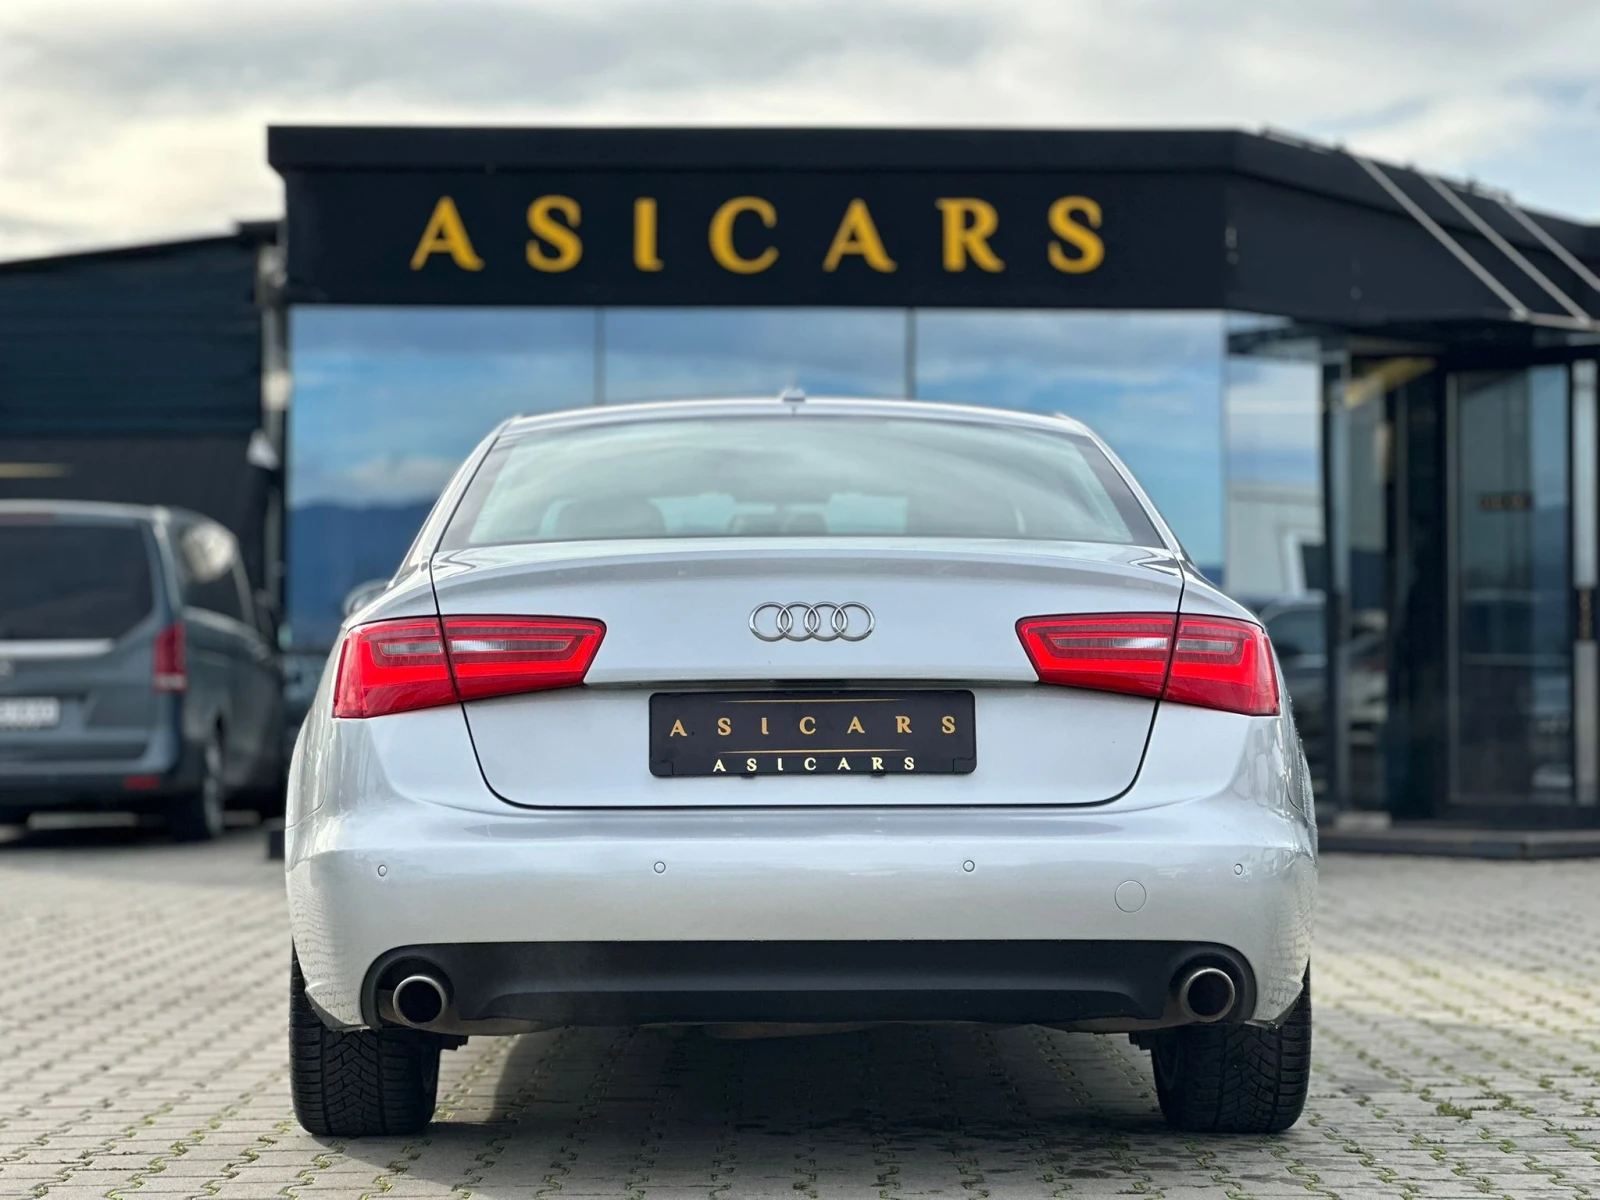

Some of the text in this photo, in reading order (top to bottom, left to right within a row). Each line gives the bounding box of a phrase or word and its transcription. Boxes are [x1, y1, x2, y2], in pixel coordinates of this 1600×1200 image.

[410, 194, 1105, 273] ASICARS
[669, 715, 956, 737] ASICARS
[713, 757, 915, 773] ASICARS
